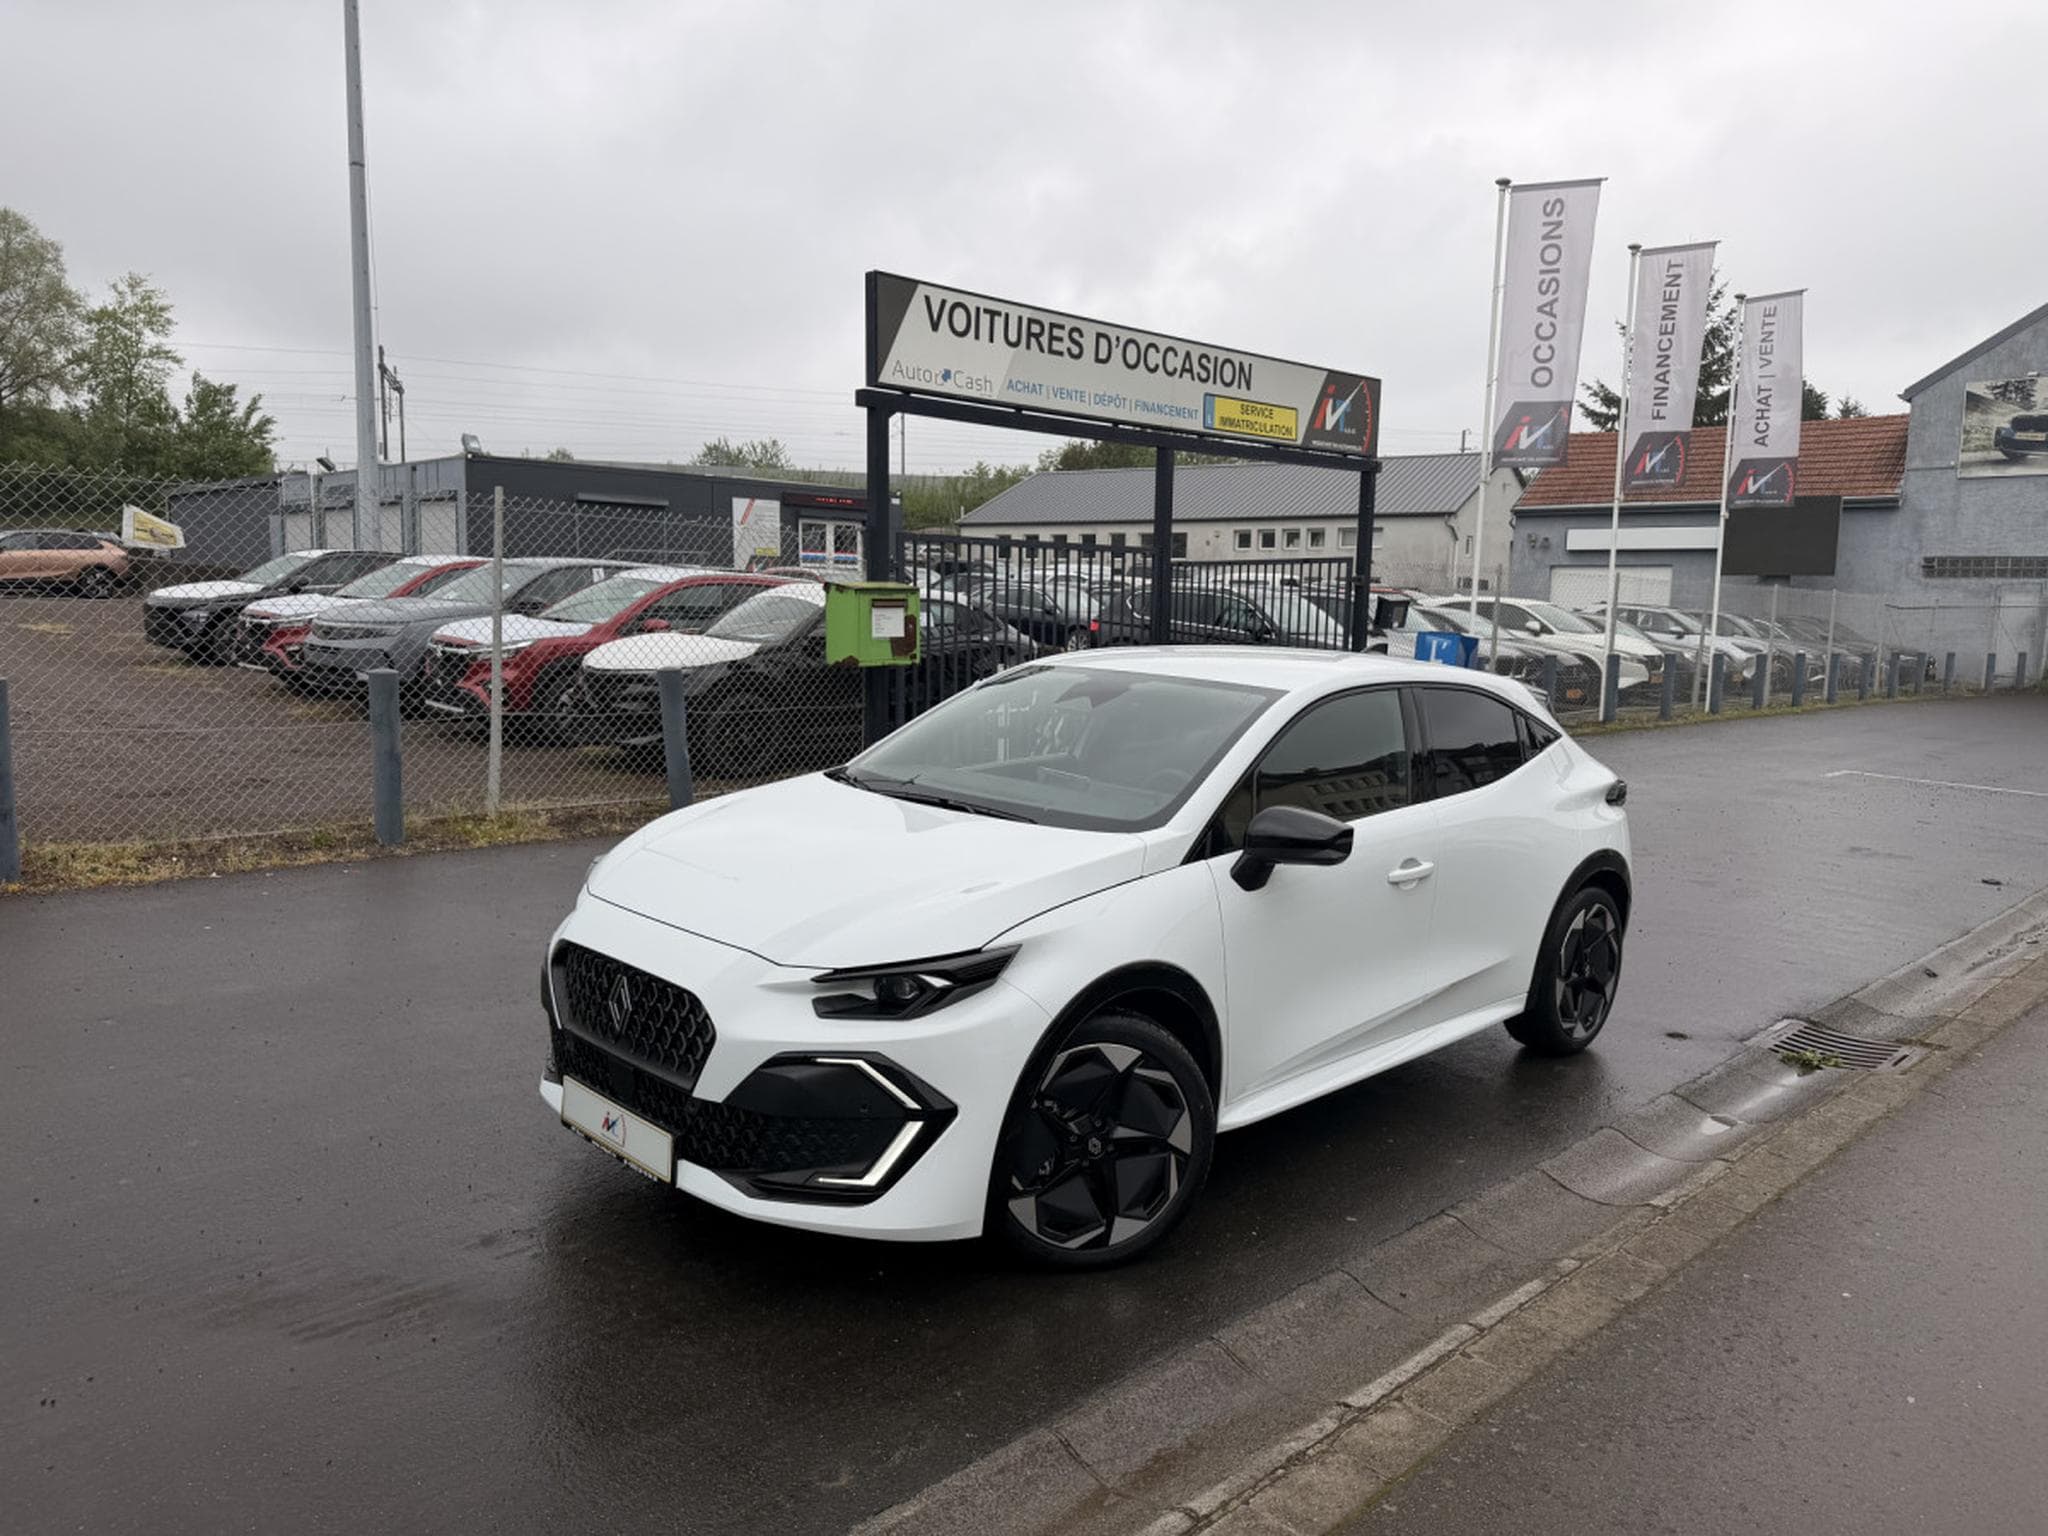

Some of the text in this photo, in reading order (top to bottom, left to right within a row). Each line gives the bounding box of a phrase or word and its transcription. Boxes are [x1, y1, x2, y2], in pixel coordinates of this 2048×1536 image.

[1531, 197, 1565, 388] OCCASIONS
[924, 294, 1253, 391] VOITURES D'OCCASION
[1651, 259, 1684, 421] FINANCEMENT
[953, 370, 993, 392] Cash
[1006, 379, 1043, 396] ACHAT
[1051, 386, 1087, 404] VENTE
[1093, 393, 1127, 409] DÉPÔT
[1134, 399, 1199, 421] FINANCEMENT
[1754, 305, 1778, 447] ACHAT VENTE
[1219, 416, 1294, 437] IMMATRICULATION
[1240, 403, 1275, 419] SERVICE
